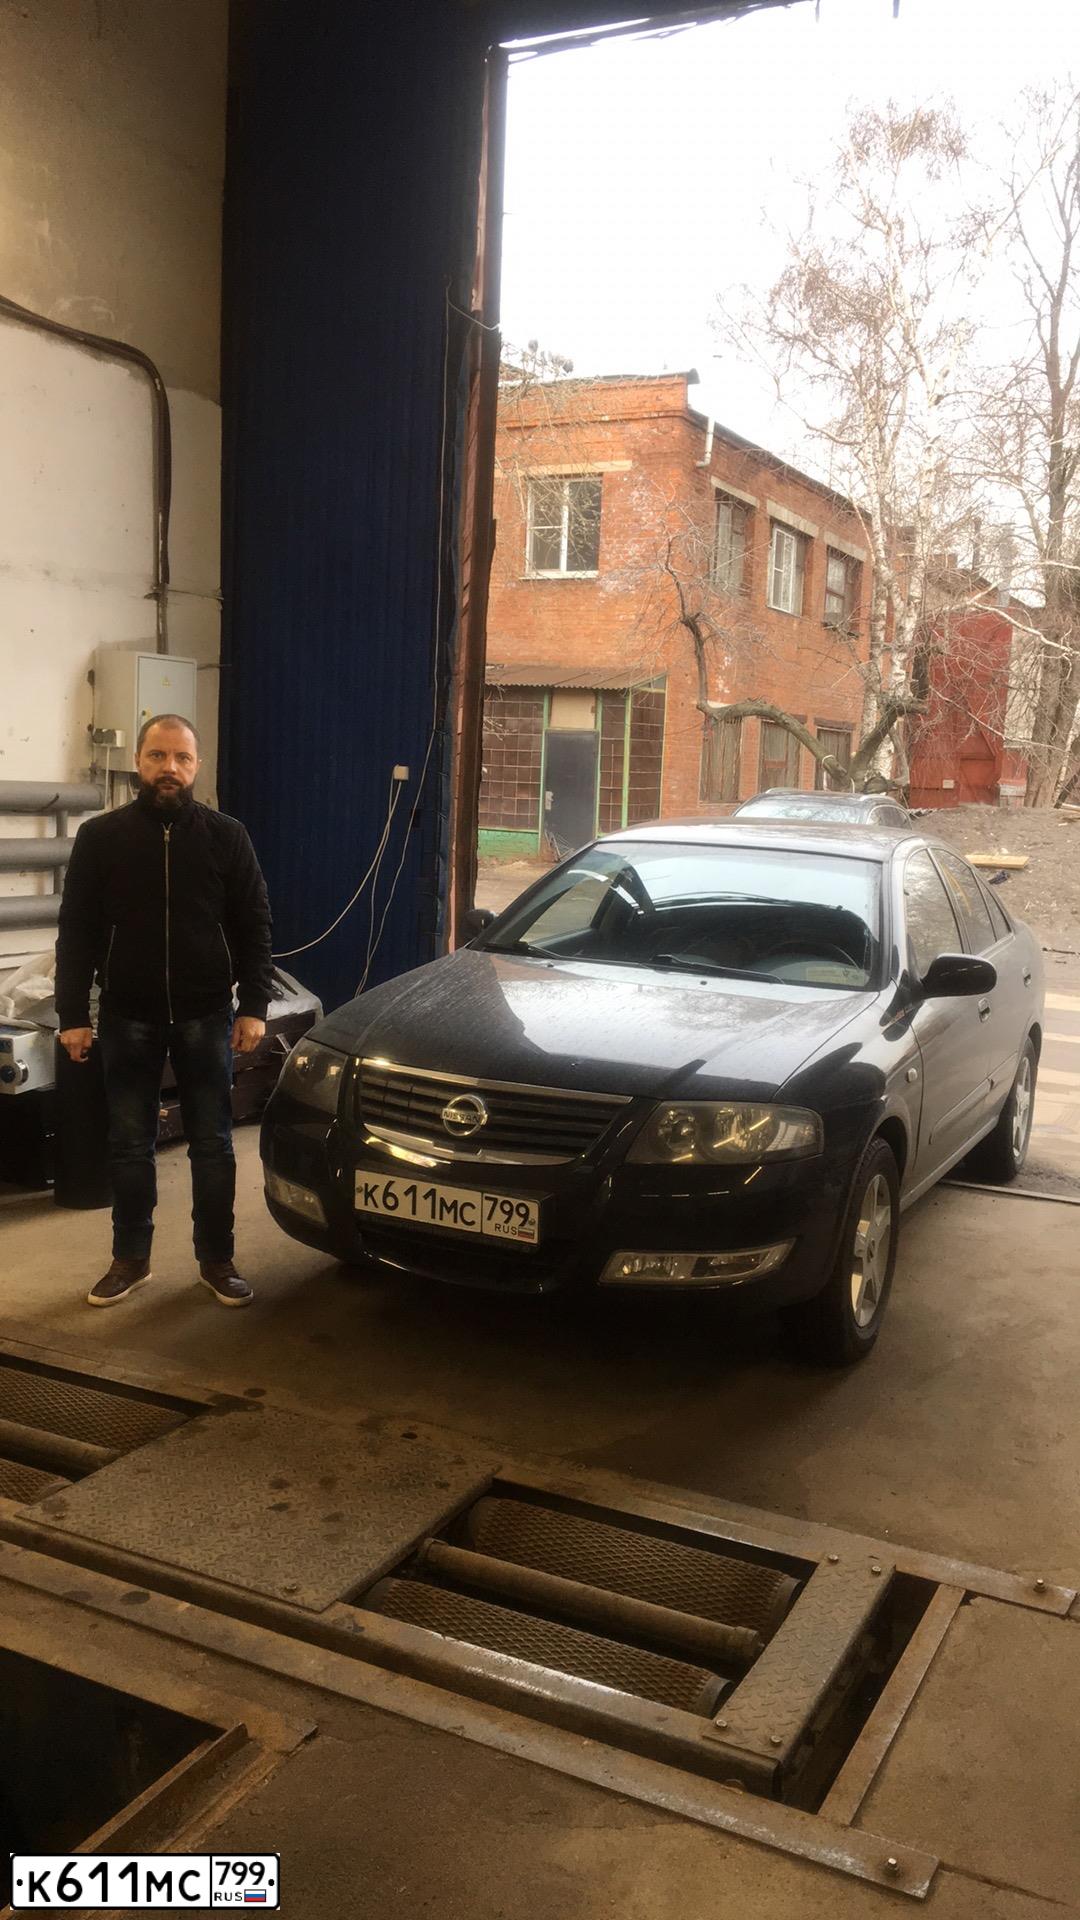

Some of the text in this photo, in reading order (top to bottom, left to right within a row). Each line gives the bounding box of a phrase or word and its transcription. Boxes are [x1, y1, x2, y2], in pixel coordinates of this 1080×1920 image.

[443, 1110, 480, 1123] NISSAN
[484, 1195, 530, 1227] 799
[494, 1223, 517, 1236] RUS
